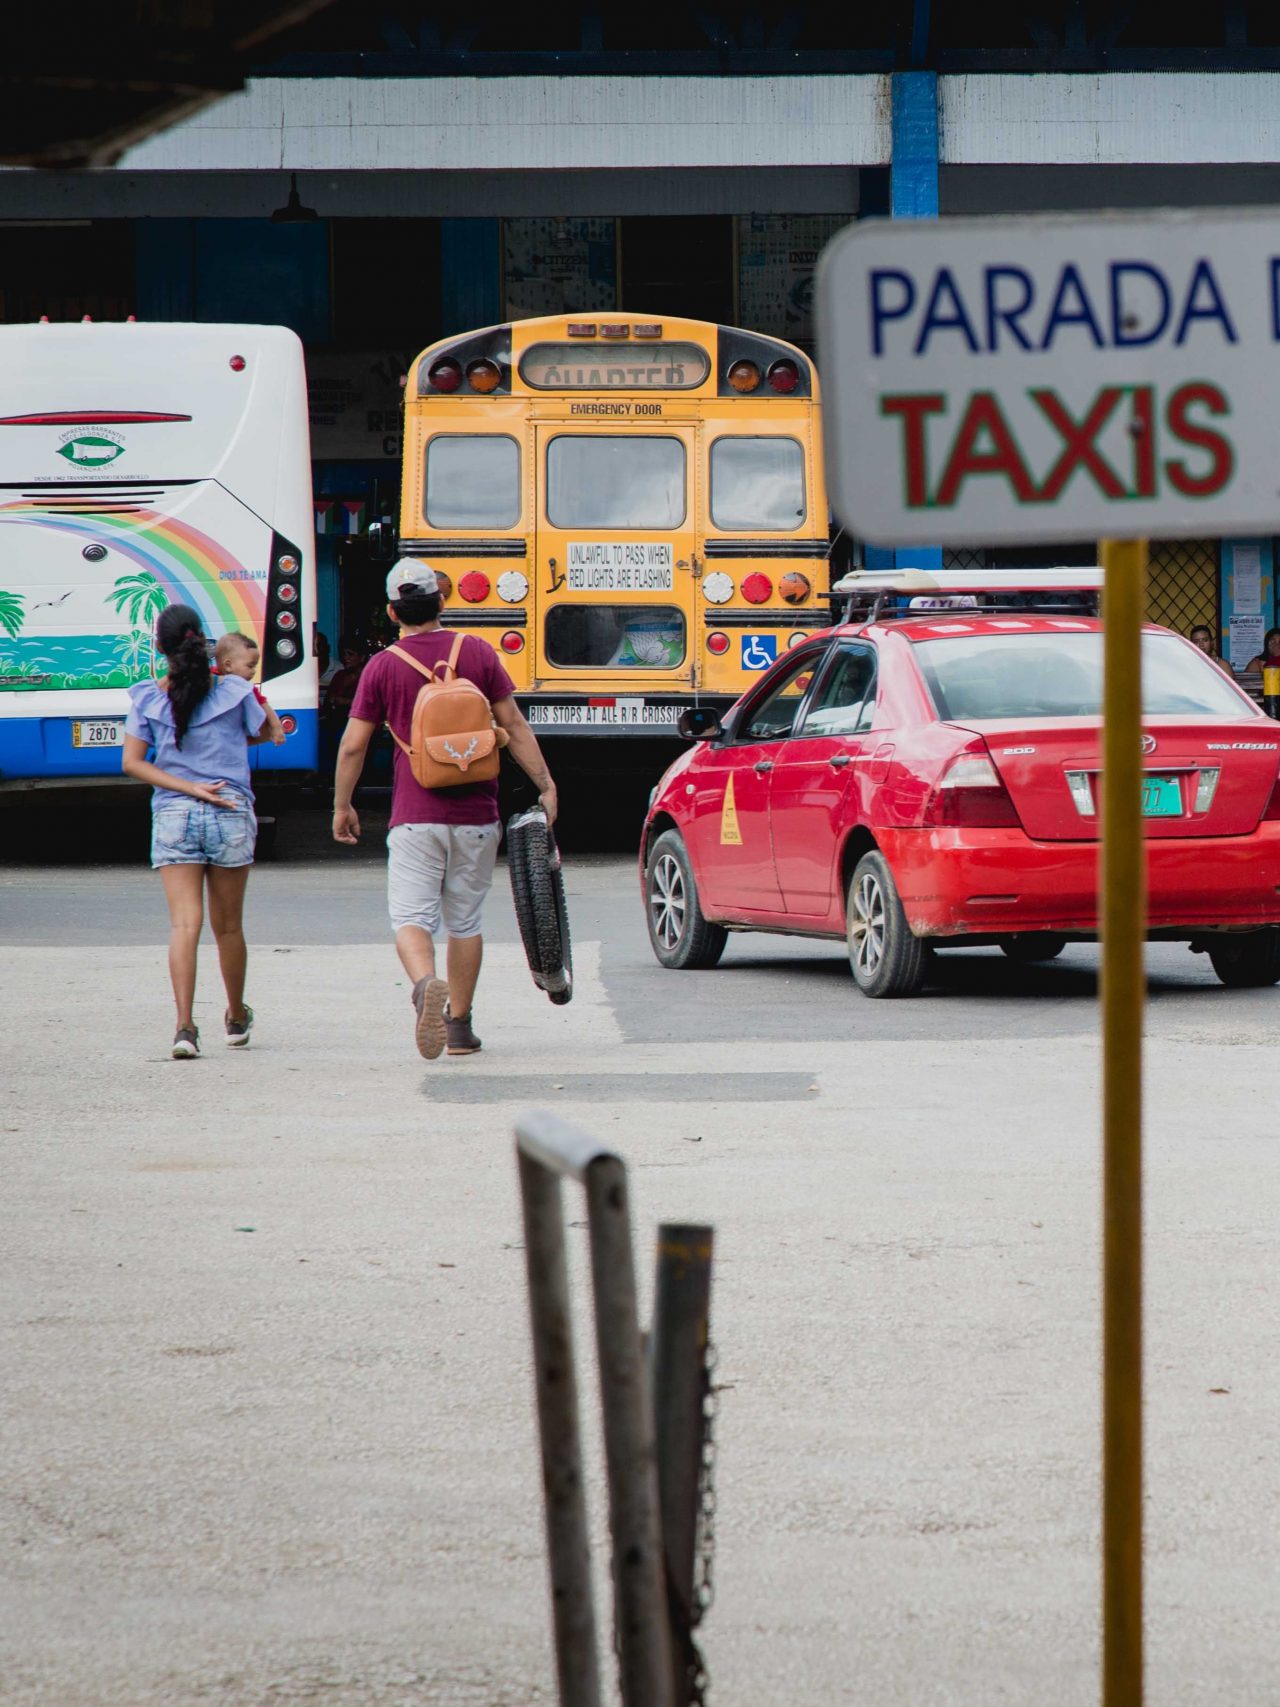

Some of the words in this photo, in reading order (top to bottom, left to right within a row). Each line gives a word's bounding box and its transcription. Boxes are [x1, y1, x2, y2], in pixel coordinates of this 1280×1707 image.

[868, 257, 1239, 357] PARADA
[570, 404, 631, 415] EMERGENCY
[634, 404, 662, 415] DOOR
[879, 379, 1236, 508] TAXIS
[570, 545, 610, 565] UNLAWFUL
[613, 545, 622, 565] TO
[625, 545, 645, 565] PASS
[648, 545, 670, 565] WHEN
[219, 570, 236, 580] DIOS
[239, 570, 249, 580] TE
[251, 570, 267, 579] AMA
[570, 568, 584, 588] RED
[588, 568, 614, 588] LIGHTS
[617, 568, 631, 588] ARE
[635, 568, 671, 588] FLASHING
[530, 706, 549, 723] BUS
[552, 706, 582, 723] STOPS
[586, 706, 598, 723] AT
[621, 706, 638, 723] R/R
[89, 727, 117, 741] 2870
